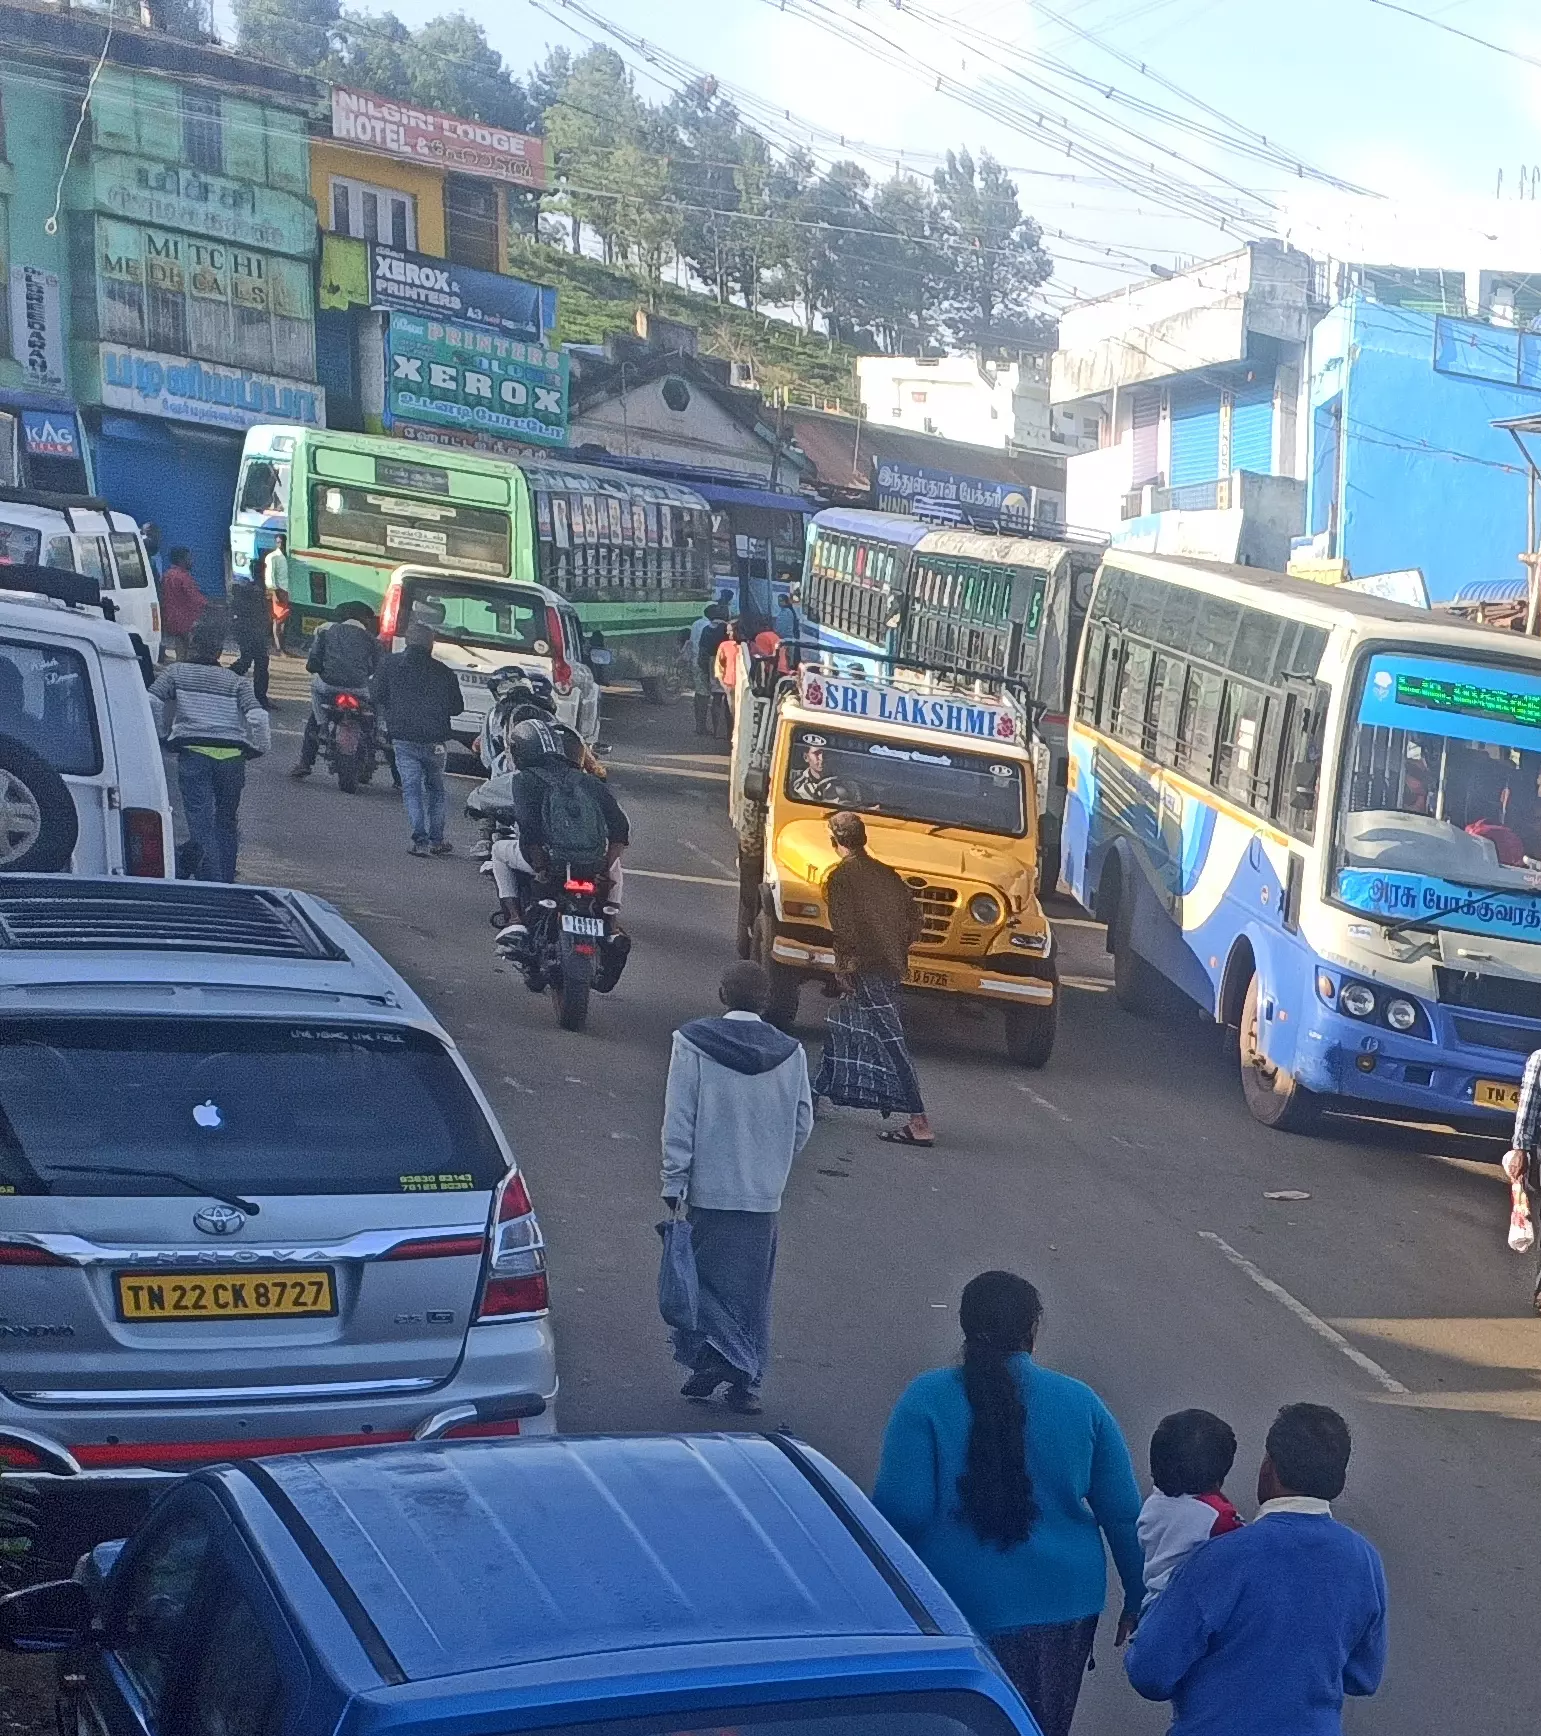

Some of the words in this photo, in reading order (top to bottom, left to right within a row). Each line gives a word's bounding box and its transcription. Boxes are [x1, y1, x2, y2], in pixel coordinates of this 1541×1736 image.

[338, 89, 434, 131] NILGIRI
[443, 119, 525, 156] LODGE
[340, 112, 412, 153] HOTEL
[104, 253, 266, 304] MEDICALS
[376, 256, 450, 293] XEROX
[376, 279, 462, 309] PRINTERS
[427, 322, 560, 369] PRINTERS
[393, 354, 561, 414] XEROX
[25, 420, 73, 443] KAG
[825, 682, 868, 716] SRI
[879, 692, 996, 737] LAKSHMI
[1368, 877, 1417, 910] அரசு
[1486, 1086, 1506, 1102] TN
[125, 1249, 328, 1266] INNOVA
[127, 1285, 166, 1312] TN
[171, 1283, 206, 1311] 22
[212, 1283, 248, 1309] CK
[254, 1279, 325, 1307] 8727
